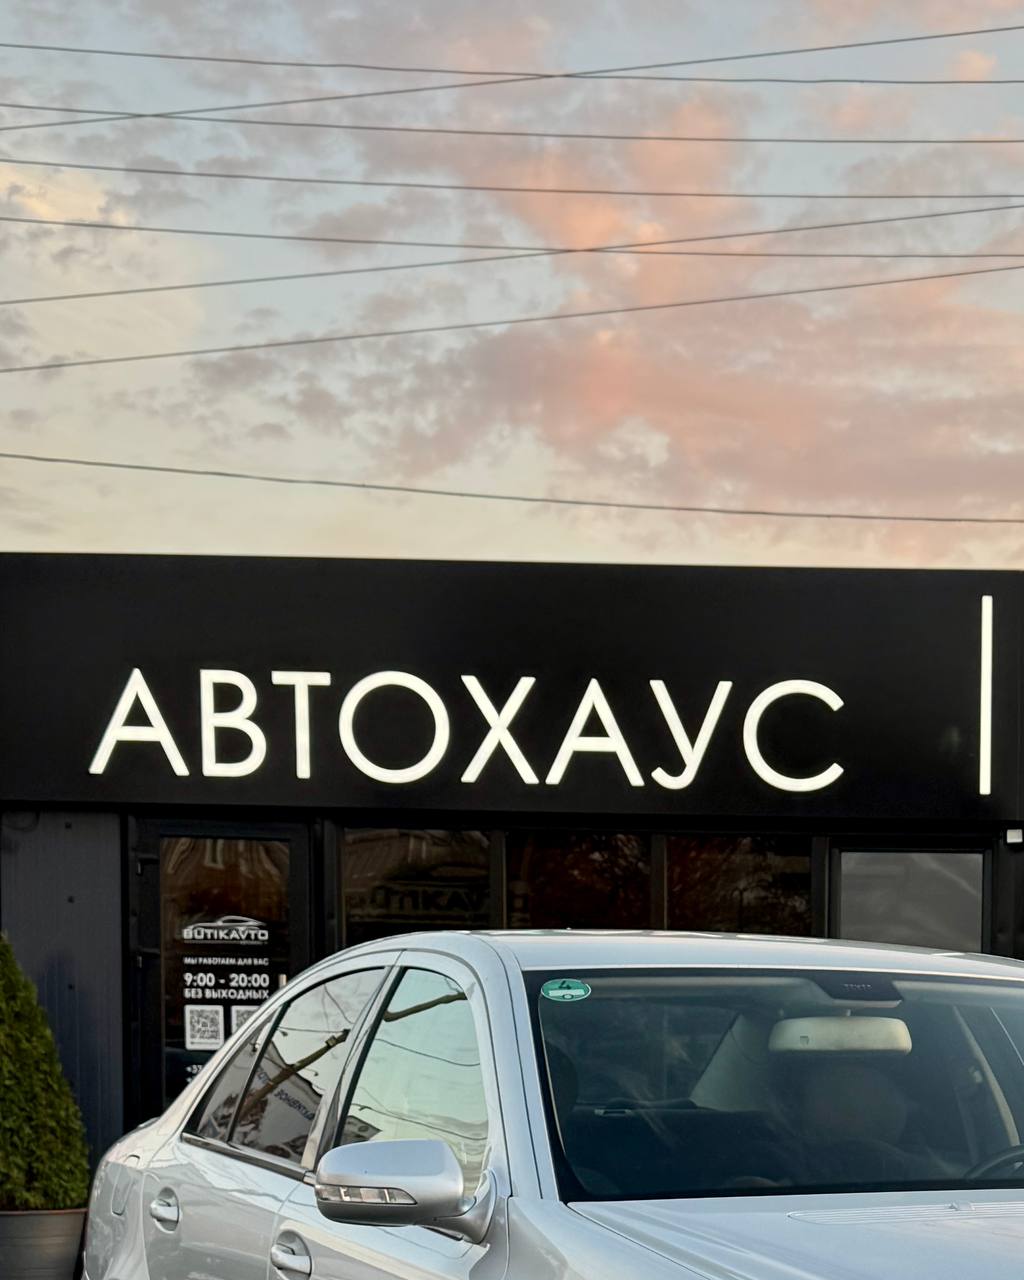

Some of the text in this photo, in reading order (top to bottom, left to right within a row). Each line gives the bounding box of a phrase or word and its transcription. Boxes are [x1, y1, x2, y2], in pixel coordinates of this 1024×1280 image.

[88, 667, 845, 792] АВТОХАУС
[183, 928, 269, 940] BUTIKAVTO
[183, 972, 216, 986] 9:00
[229, 973, 270, 987] 20:00
[183, 988, 269, 1000] БЕЗ ВЫХОДНЫХ
